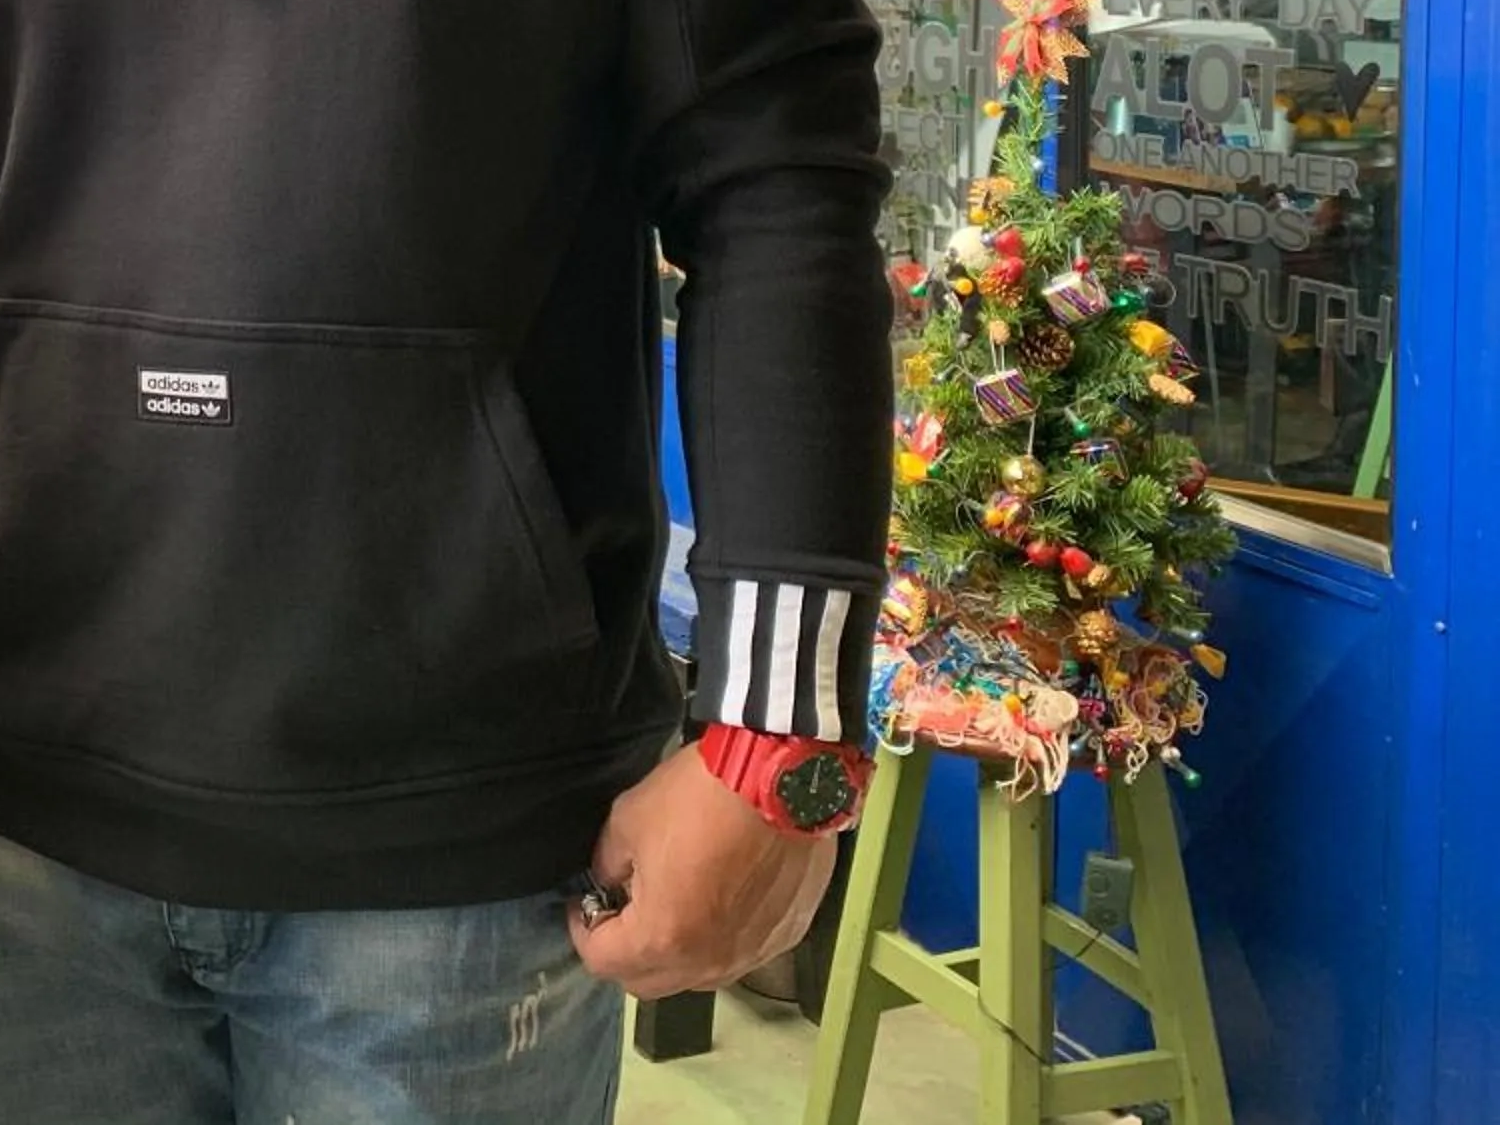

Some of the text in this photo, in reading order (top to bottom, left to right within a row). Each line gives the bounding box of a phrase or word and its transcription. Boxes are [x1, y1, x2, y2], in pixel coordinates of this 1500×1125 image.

[874, 18, 997, 101] UGH
[1092, 132, 1165, 170] ONE
[1178, 140, 1362, 199] ANOTHER
[1174, 252, 1394, 363] TRUTH
[147, 376, 199, 394] adidas
[147, 397, 201, 416] adidas
